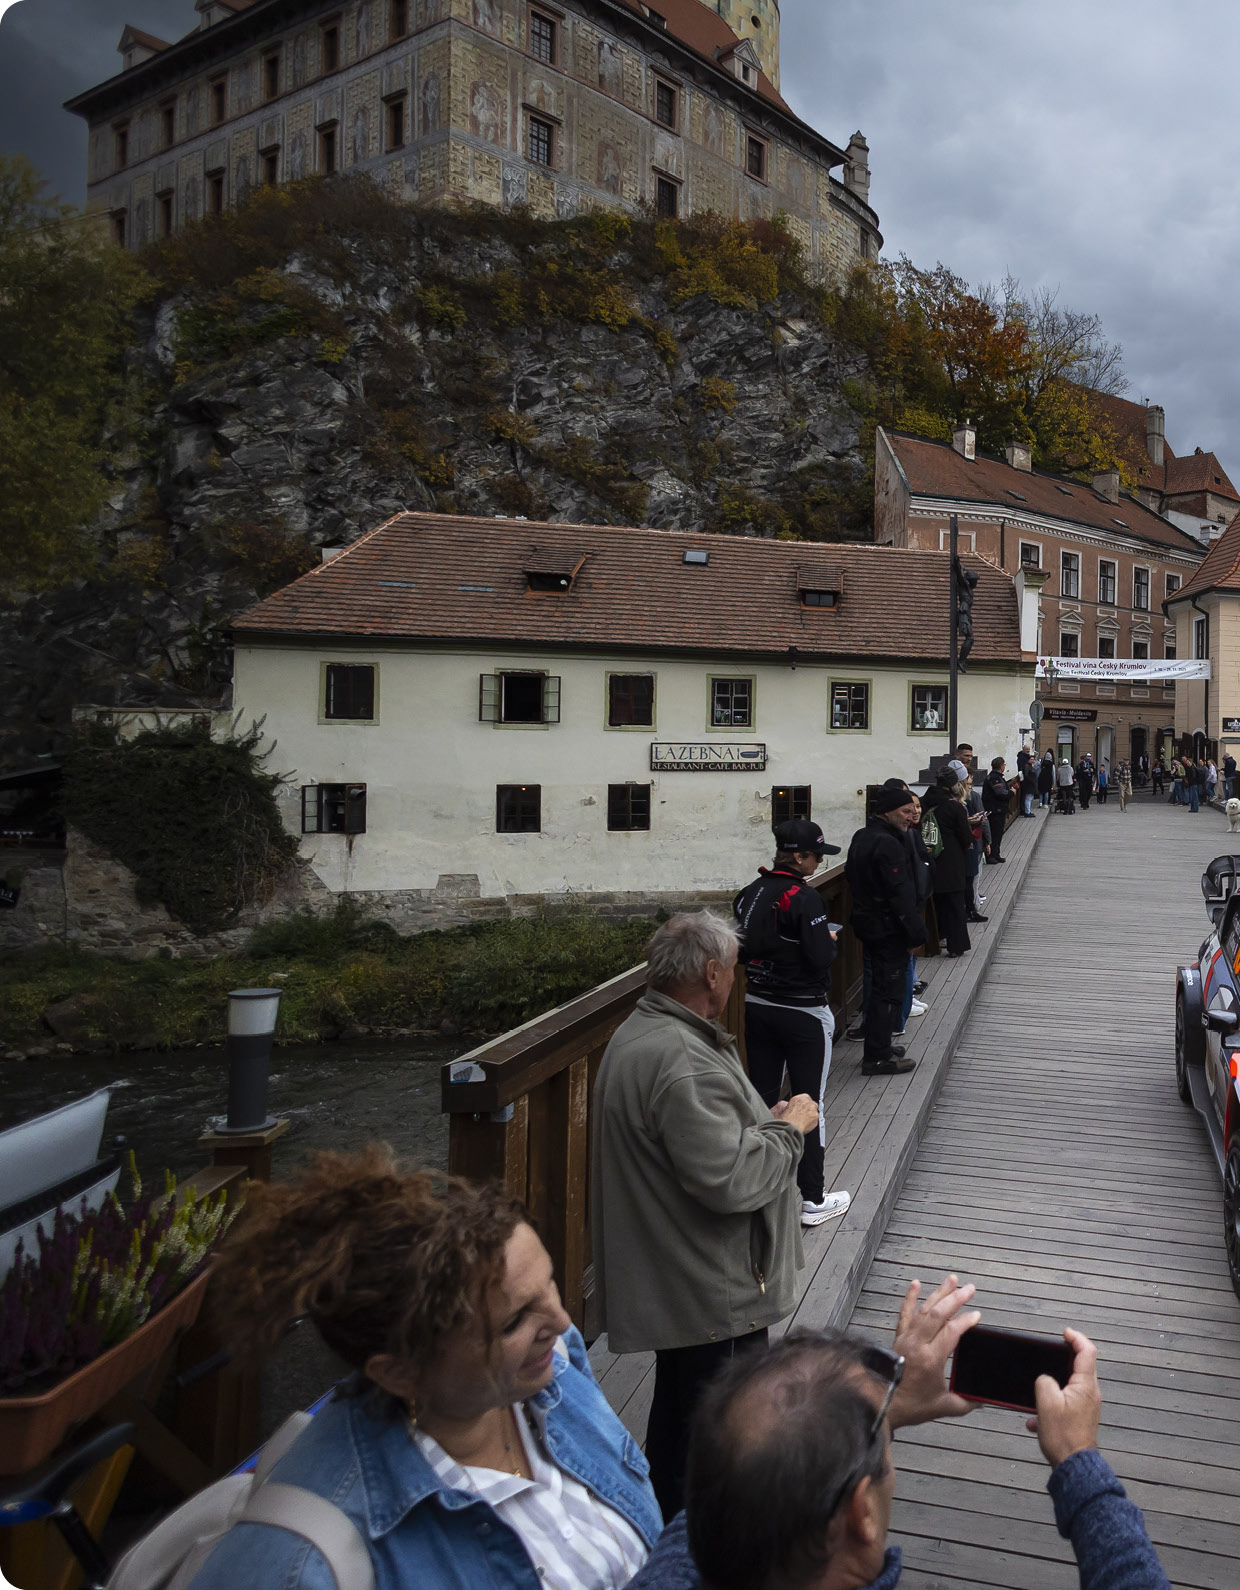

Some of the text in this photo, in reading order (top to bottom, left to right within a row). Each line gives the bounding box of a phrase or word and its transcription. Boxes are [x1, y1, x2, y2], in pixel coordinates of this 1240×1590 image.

[1055, 660, 1081, 668] Festival
[1098, 660, 1118, 670] Český
[1119, 662, 1147, 670] Krumlov
[652, 762, 705, 770] RESTAURANT
[751, 762, 765, 770] PUB
